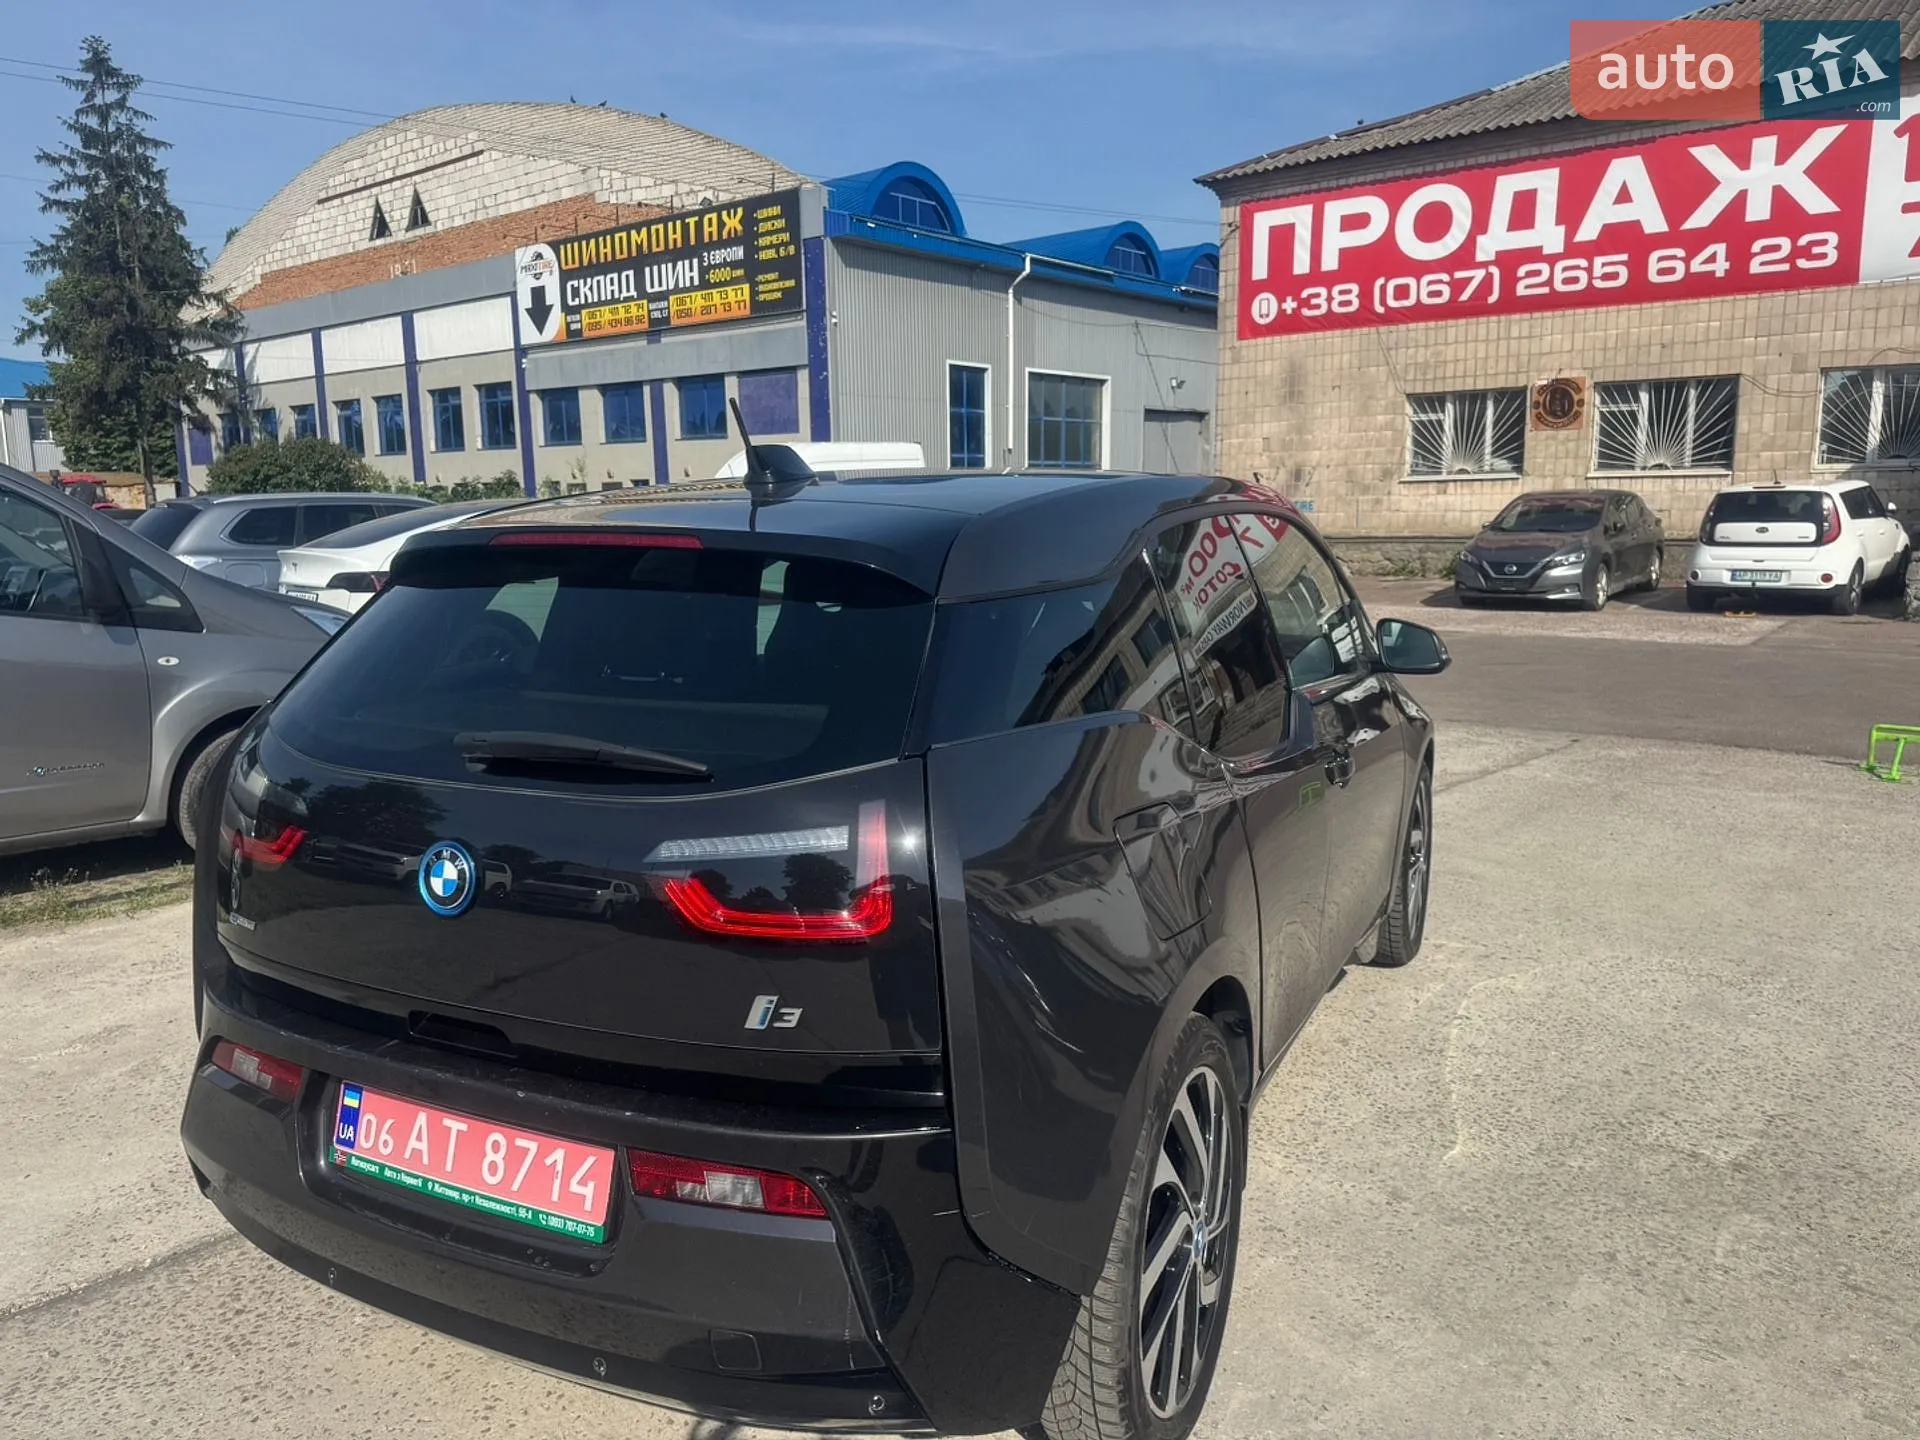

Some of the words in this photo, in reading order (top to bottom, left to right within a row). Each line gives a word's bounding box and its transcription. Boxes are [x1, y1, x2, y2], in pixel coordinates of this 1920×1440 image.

[1252, 123, 1848, 280] ПРОДАЖ
[559, 206, 744, 271] ШИНОМОНТАЖ
[566, 270, 637, 306] СКЛАД
[645, 258, 699, 293] ШИН
[1281, 283, 1359, 316] +38
[1373, 265, 1500, 314] (067)
[1515, 254, 1629, 297] 265
[1648, 243, 1730, 283] 64
[1749, 231, 1839, 275] 23
[744, 995, 803, 1030] i3
[338, 1122, 355, 1143] UA
[359, 1112, 396, 1157] 06
[403, 1111, 469, 1173] AT
[480, 1131, 599, 1213] 8714
